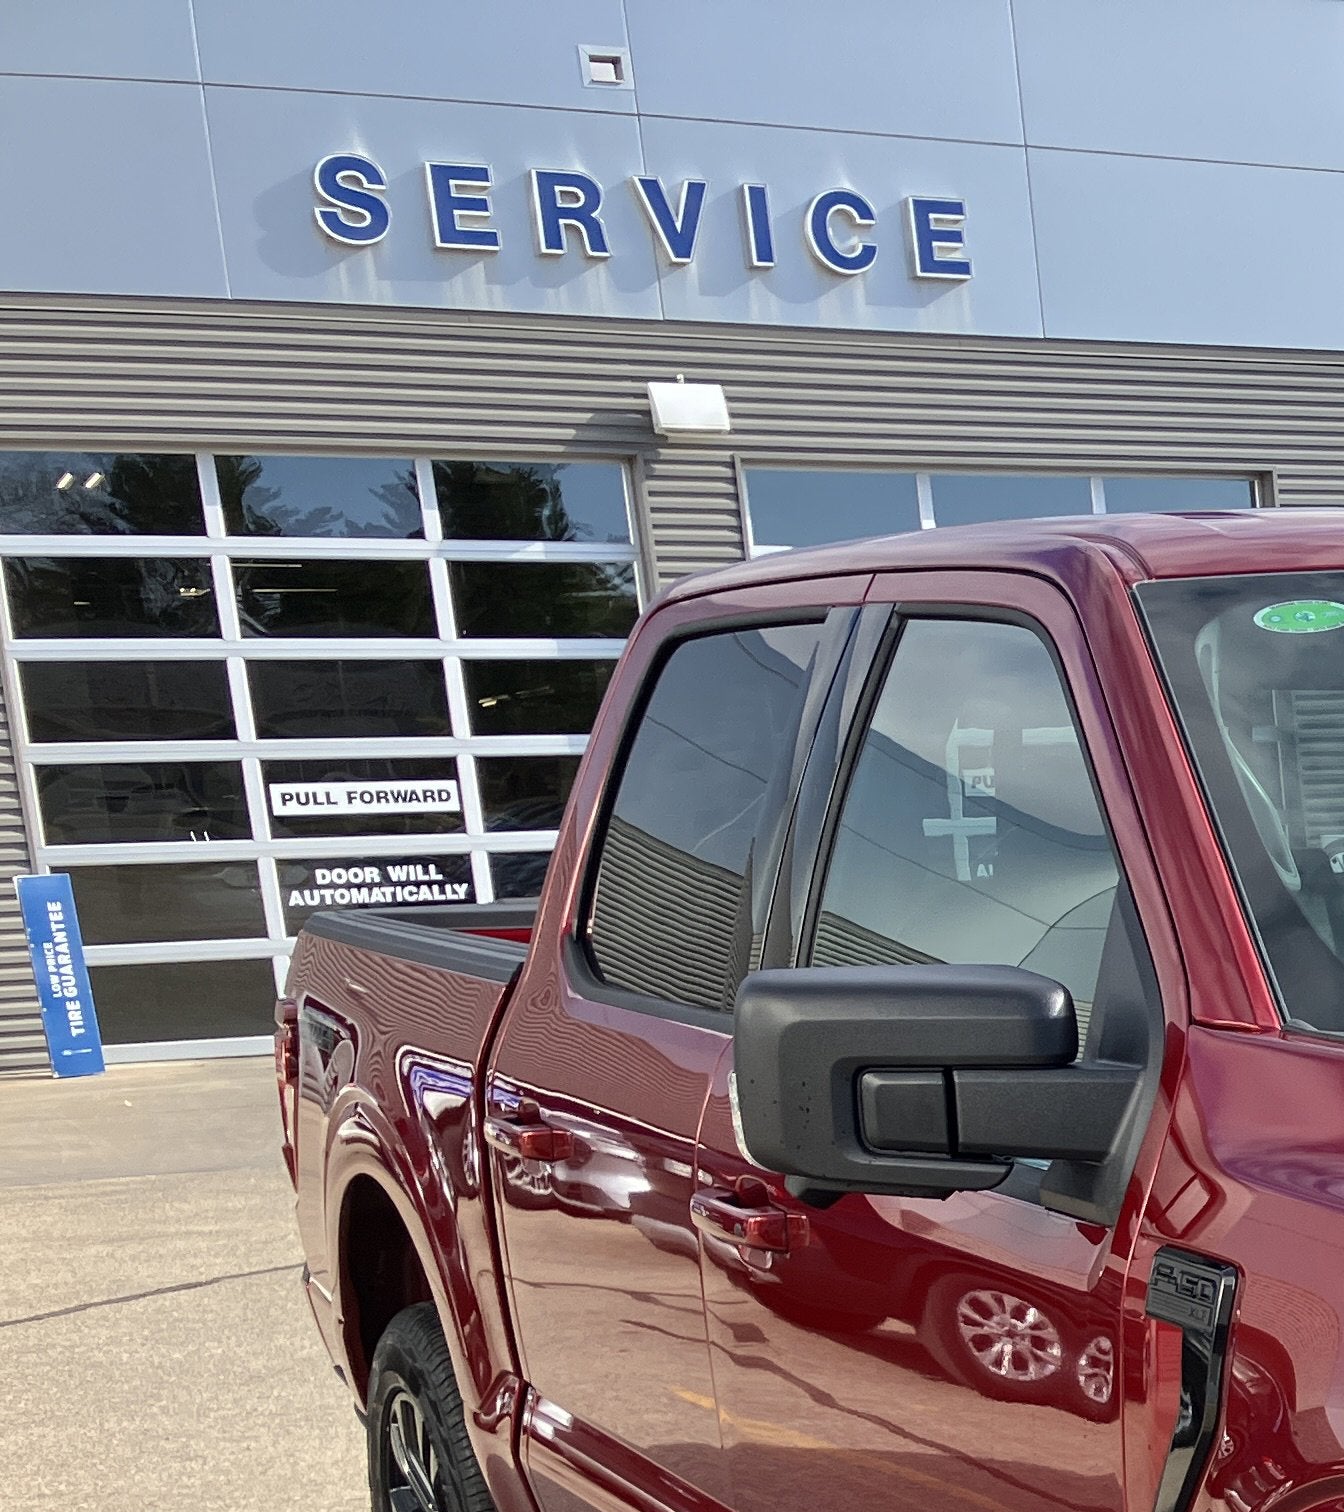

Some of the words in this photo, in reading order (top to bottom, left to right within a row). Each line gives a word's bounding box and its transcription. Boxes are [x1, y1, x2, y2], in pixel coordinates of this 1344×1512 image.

[312, 150, 974, 281] SERVICE
[280, 791, 338, 807] PULL
[346, 789, 452, 805] FORWARD
[315, 867, 381, 885] DOOR
[387, 864, 443, 882] WILL
[288, 883, 469, 907] AUTOMATICALLY
[47, 901, 79, 998] GUARANTEE
[51, 975, 63, 998] LOW
[66, 999, 86, 1037] TIRE
